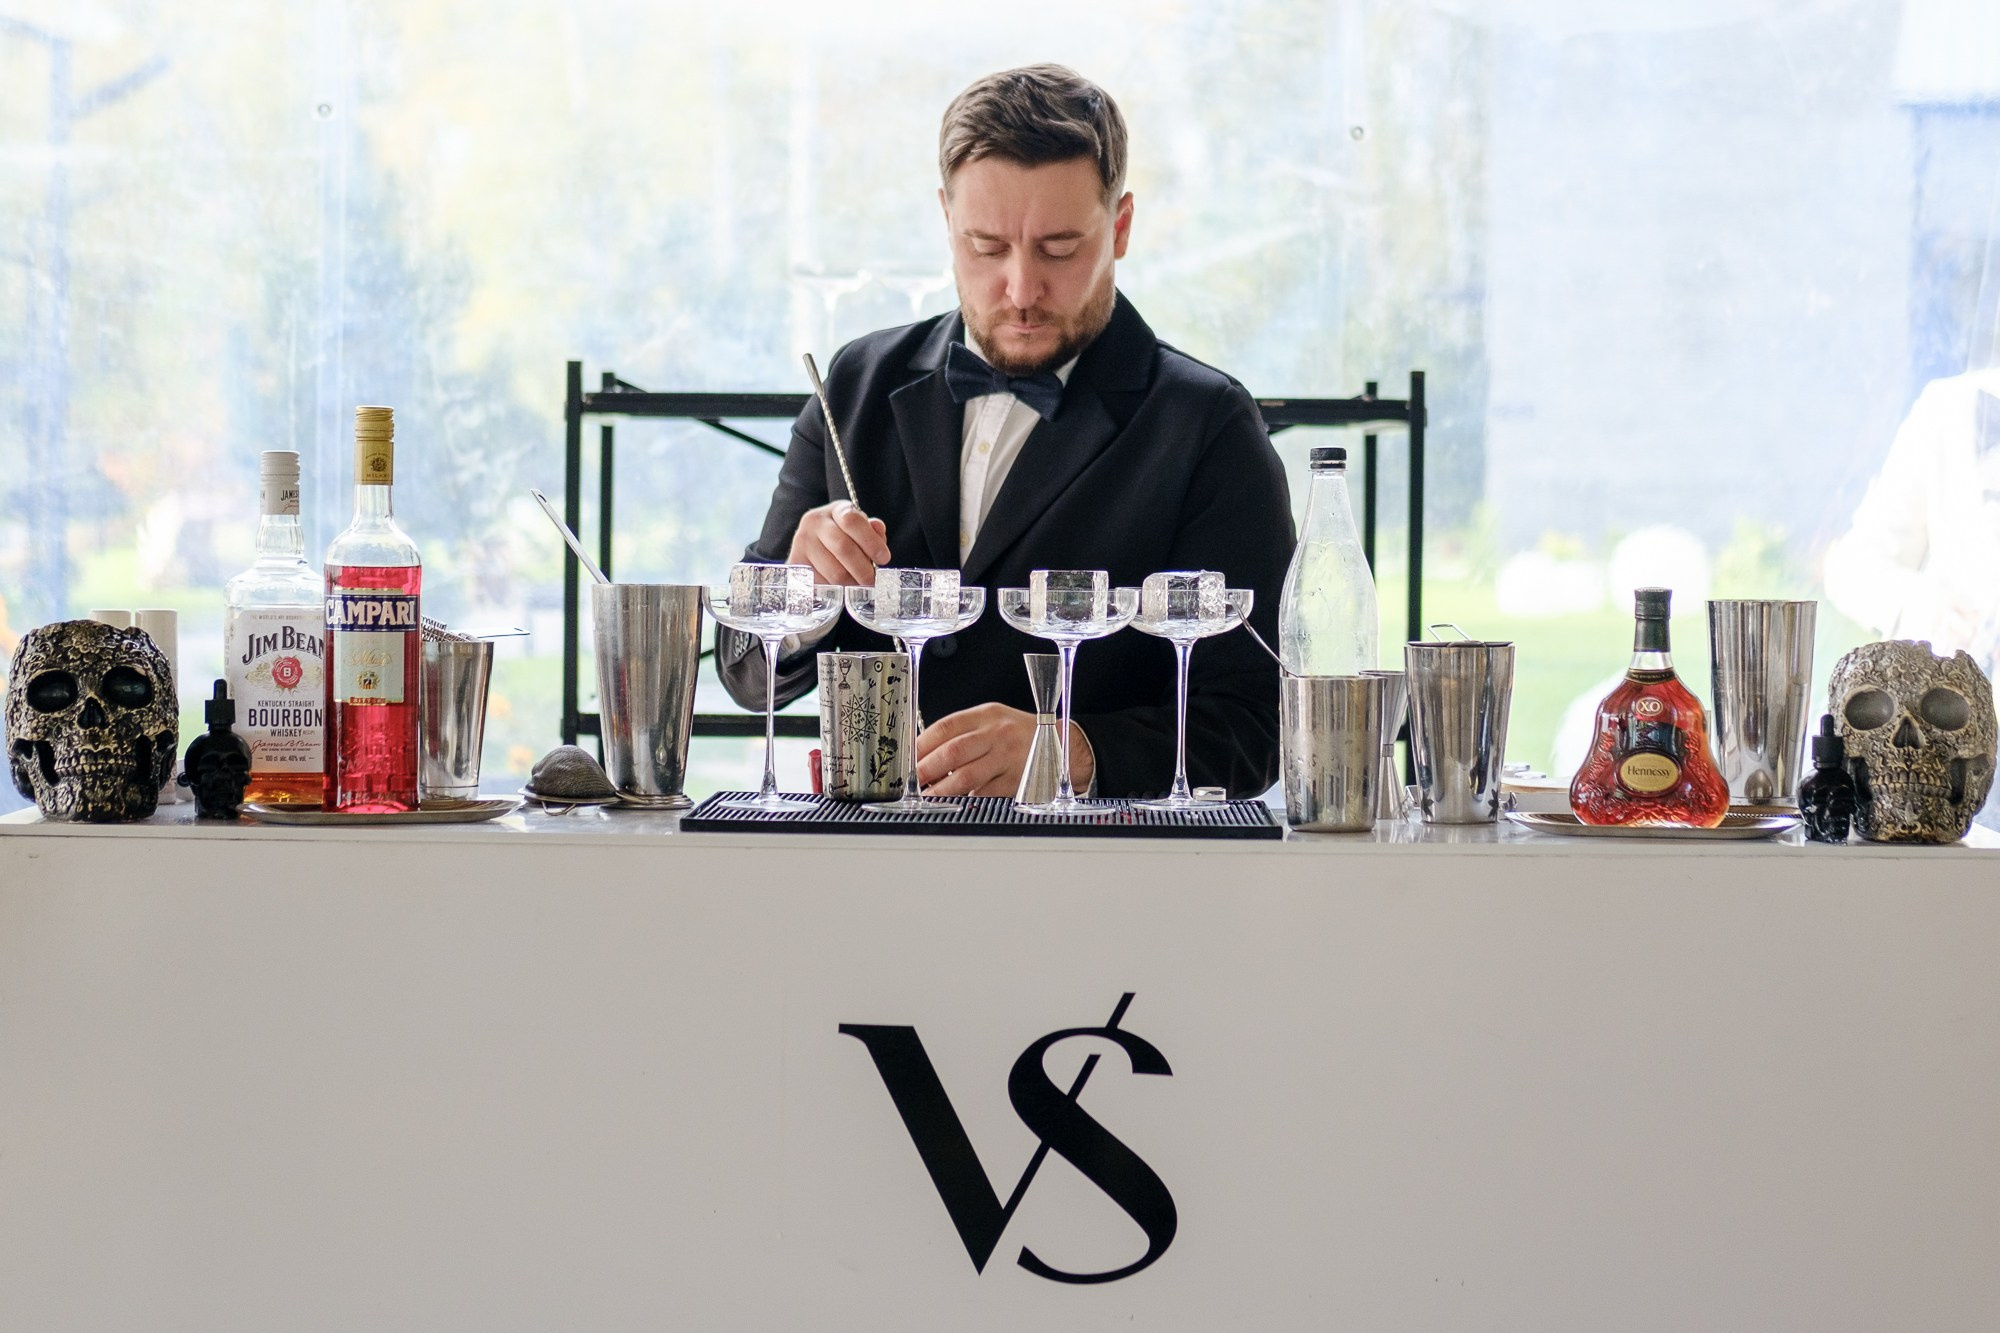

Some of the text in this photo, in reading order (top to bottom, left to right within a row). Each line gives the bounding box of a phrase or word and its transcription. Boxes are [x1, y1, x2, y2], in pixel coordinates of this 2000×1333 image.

[325, 599, 416, 625] CAMPARI
[242, 633, 278, 665] JIM
[283, 667, 292, 677] B
[248, 708, 323, 727] BOURBON
[270, 728, 302, 737] WHISKEY
[1627, 765, 1670, 778] Hennessy
